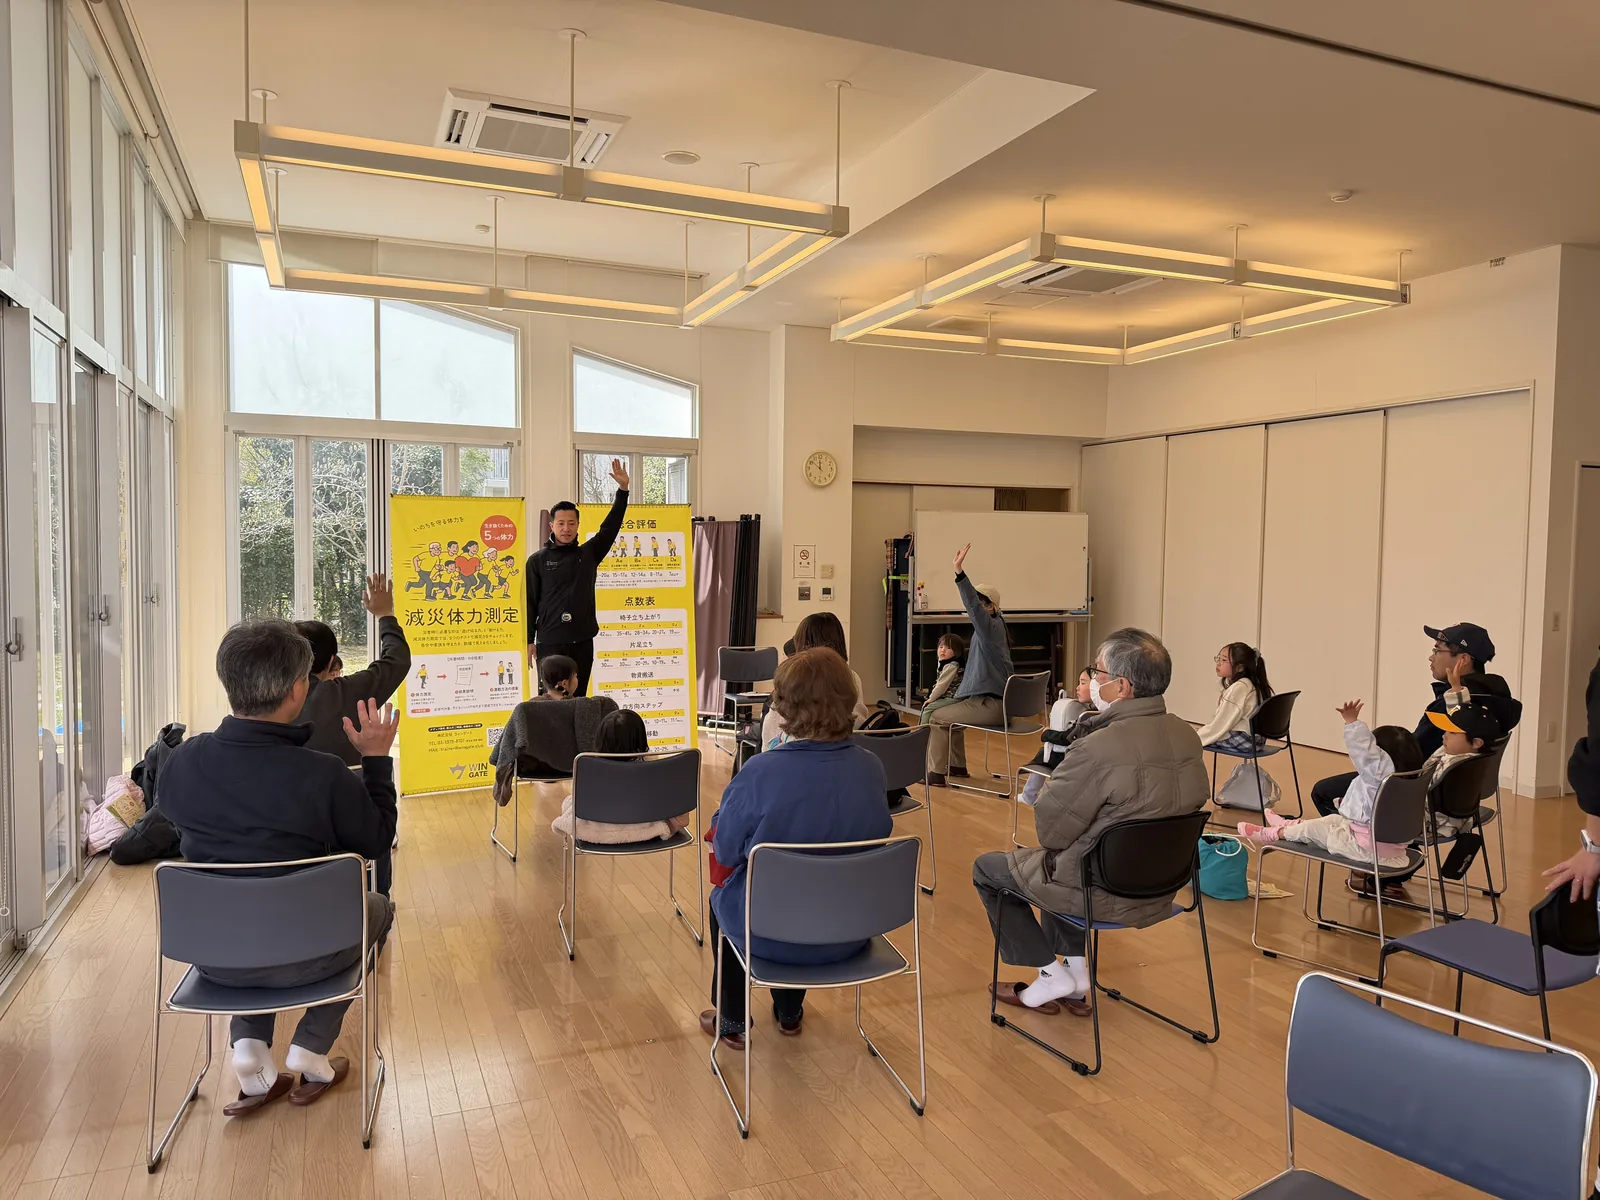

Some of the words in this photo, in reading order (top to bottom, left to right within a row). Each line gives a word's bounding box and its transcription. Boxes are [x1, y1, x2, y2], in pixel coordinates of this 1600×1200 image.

[413, 517, 464, 532] いのちを守る体力を
[484, 530, 514, 541] 5つの体力
[625, 596, 655, 606] 点数表
[405, 607, 519, 626] 減災体力測定
[469, 762, 488, 771] WIN
